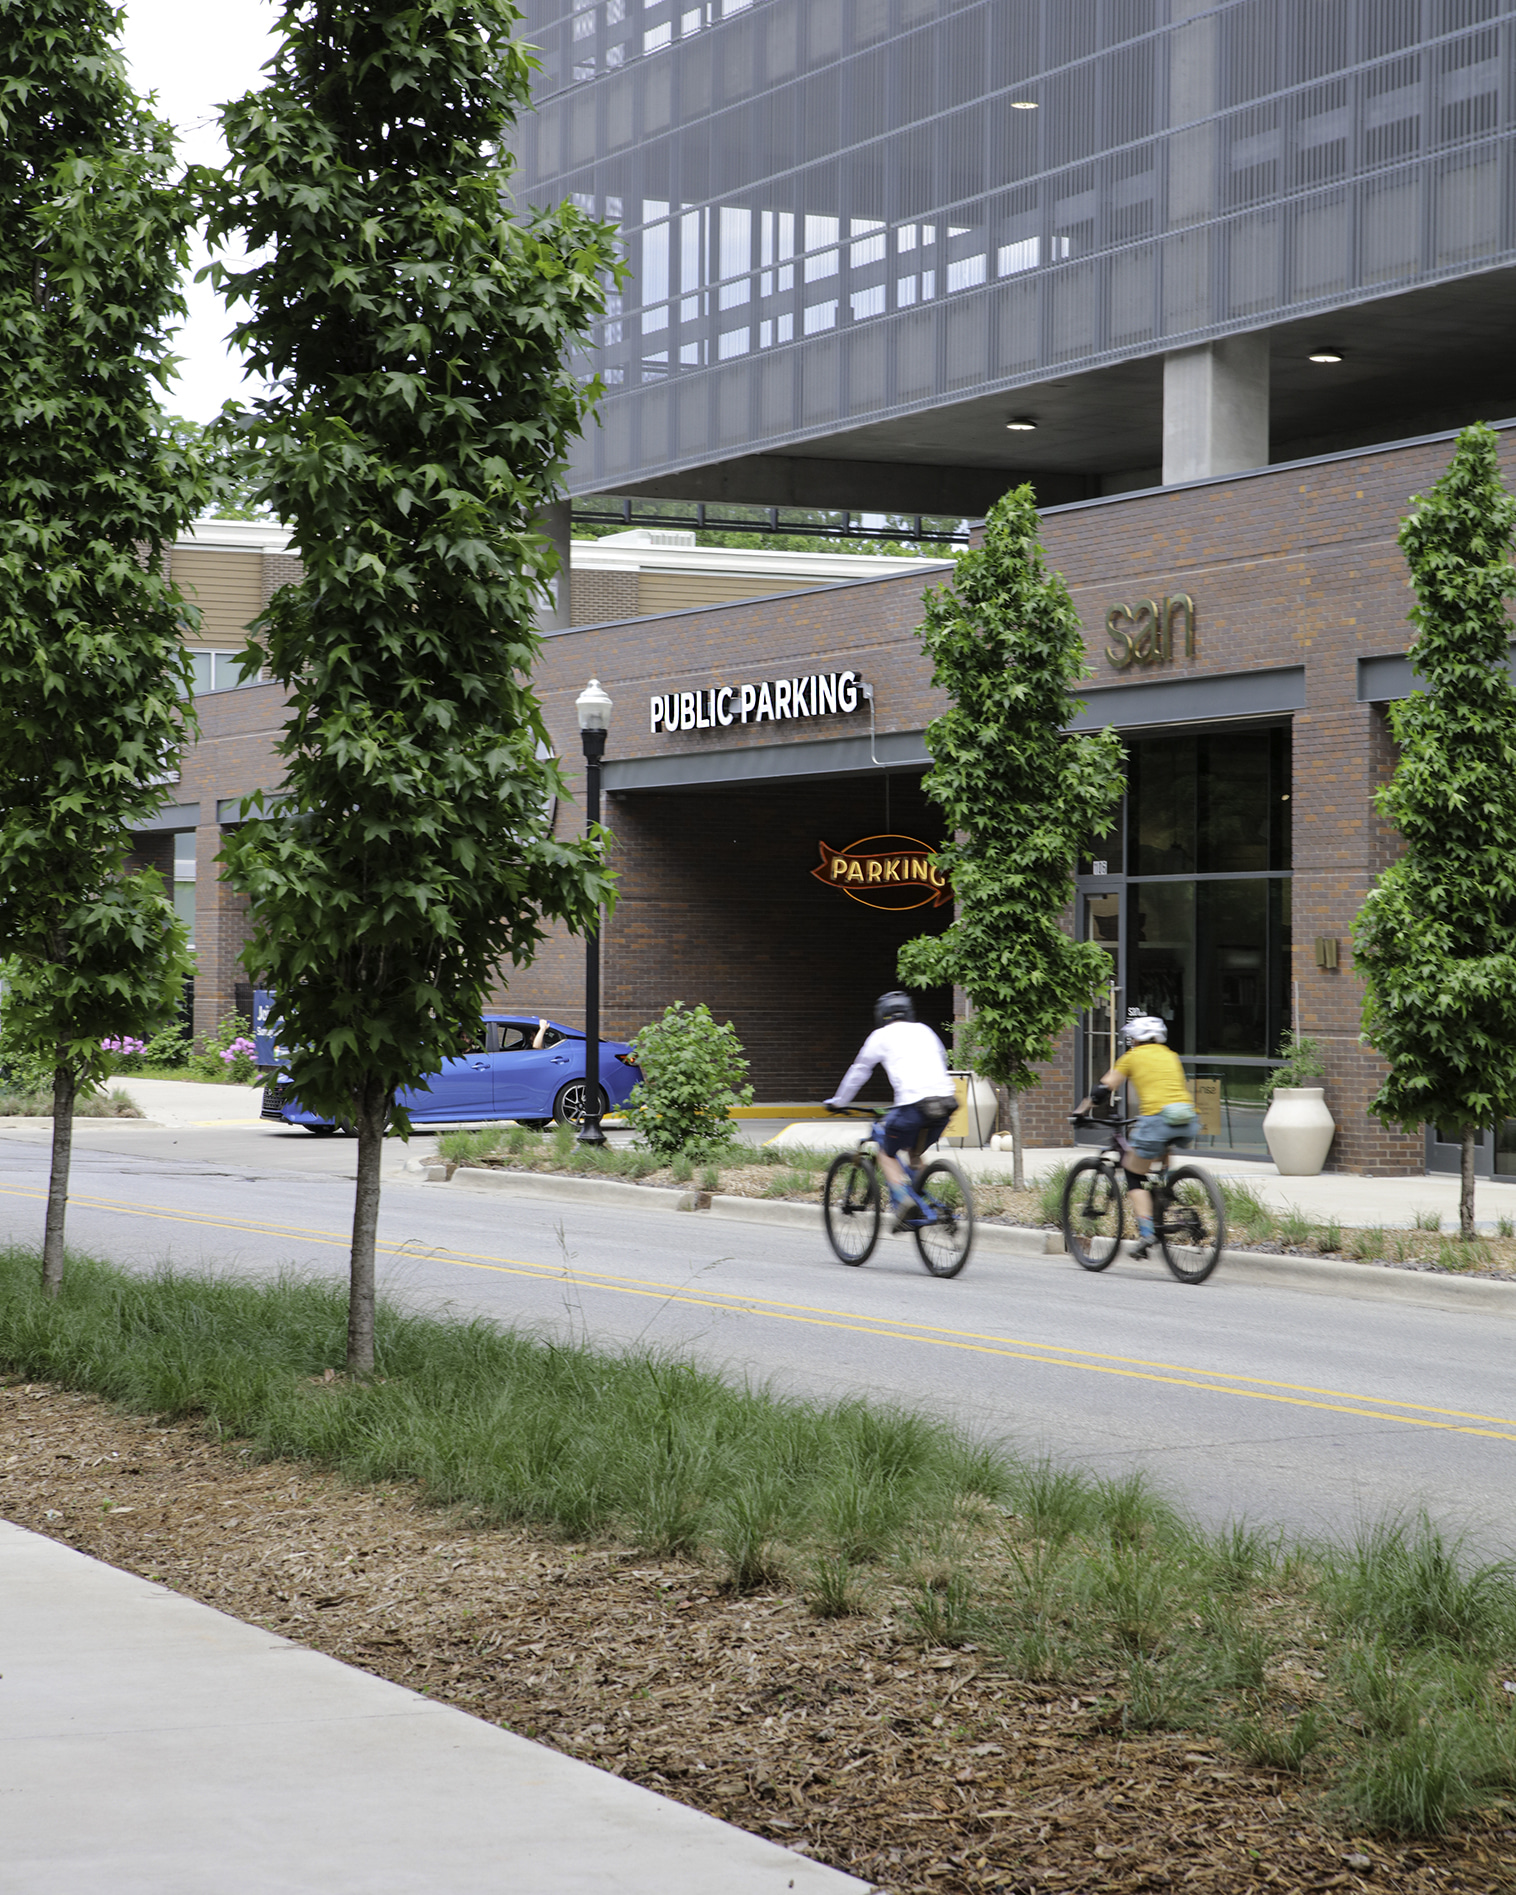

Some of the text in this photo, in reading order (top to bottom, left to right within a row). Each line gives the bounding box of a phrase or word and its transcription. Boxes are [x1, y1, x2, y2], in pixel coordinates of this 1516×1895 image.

[1105, 593, 1194, 667] san
[650, 671, 858, 733] PUBLIC PARKING
